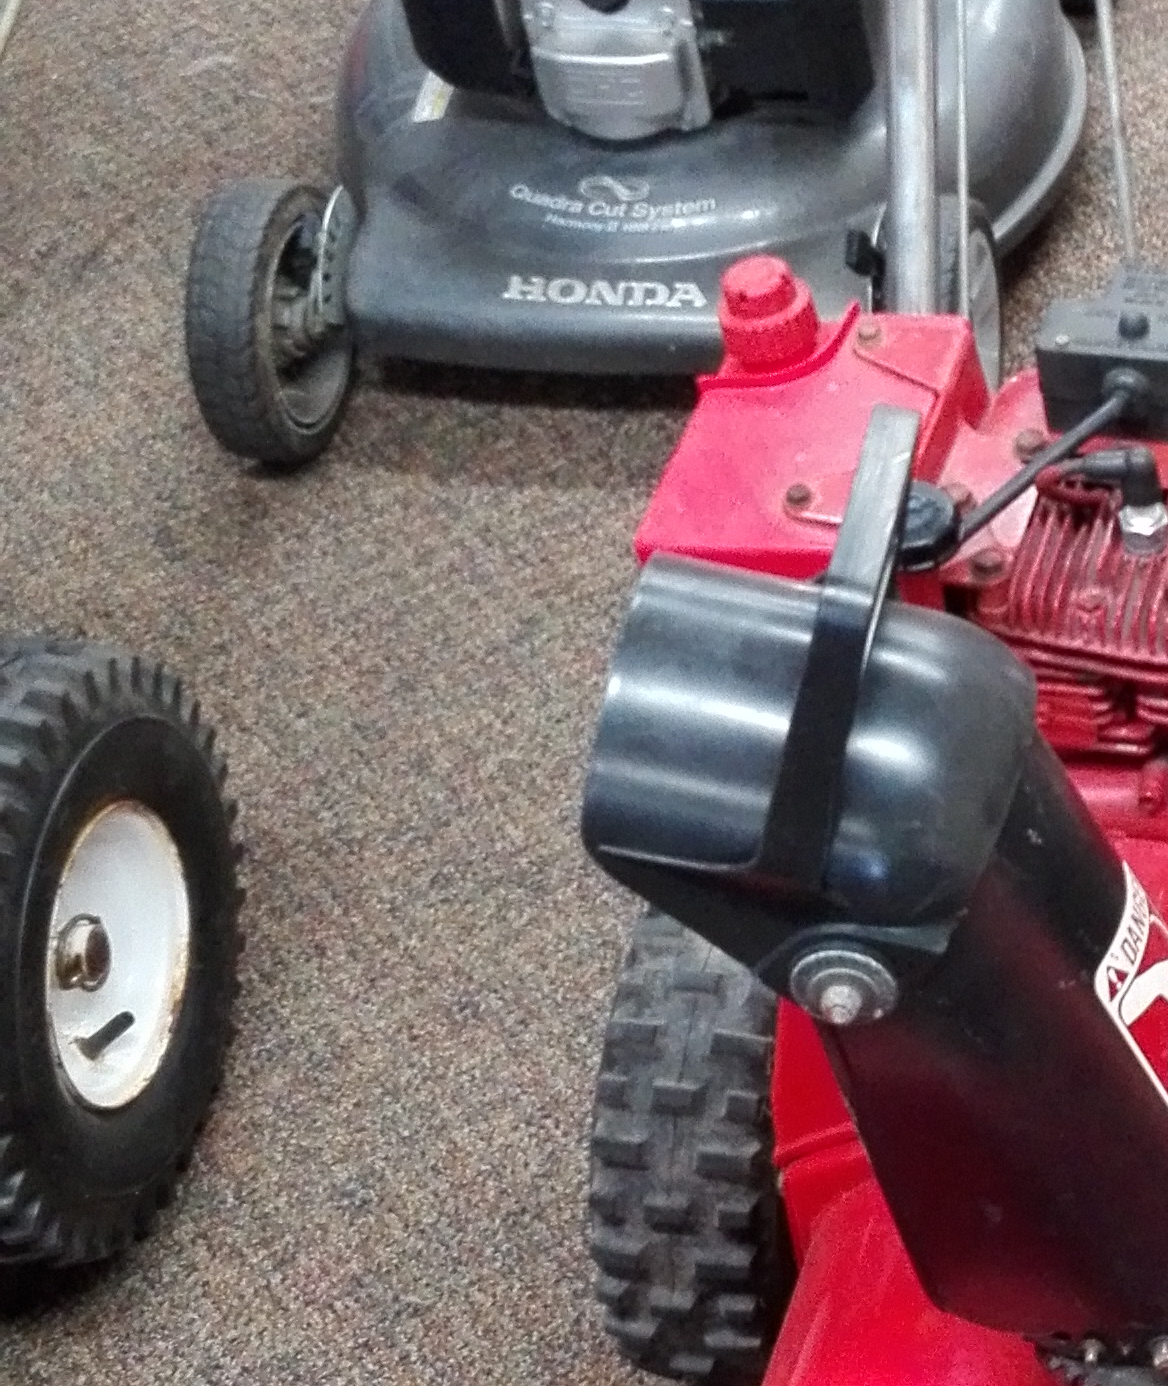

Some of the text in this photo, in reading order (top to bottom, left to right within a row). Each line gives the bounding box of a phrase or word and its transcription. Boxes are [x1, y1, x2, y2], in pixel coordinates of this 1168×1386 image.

[509, 183, 717, 221] Quadra Cut System
[502, 273, 708, 309] HONDA
